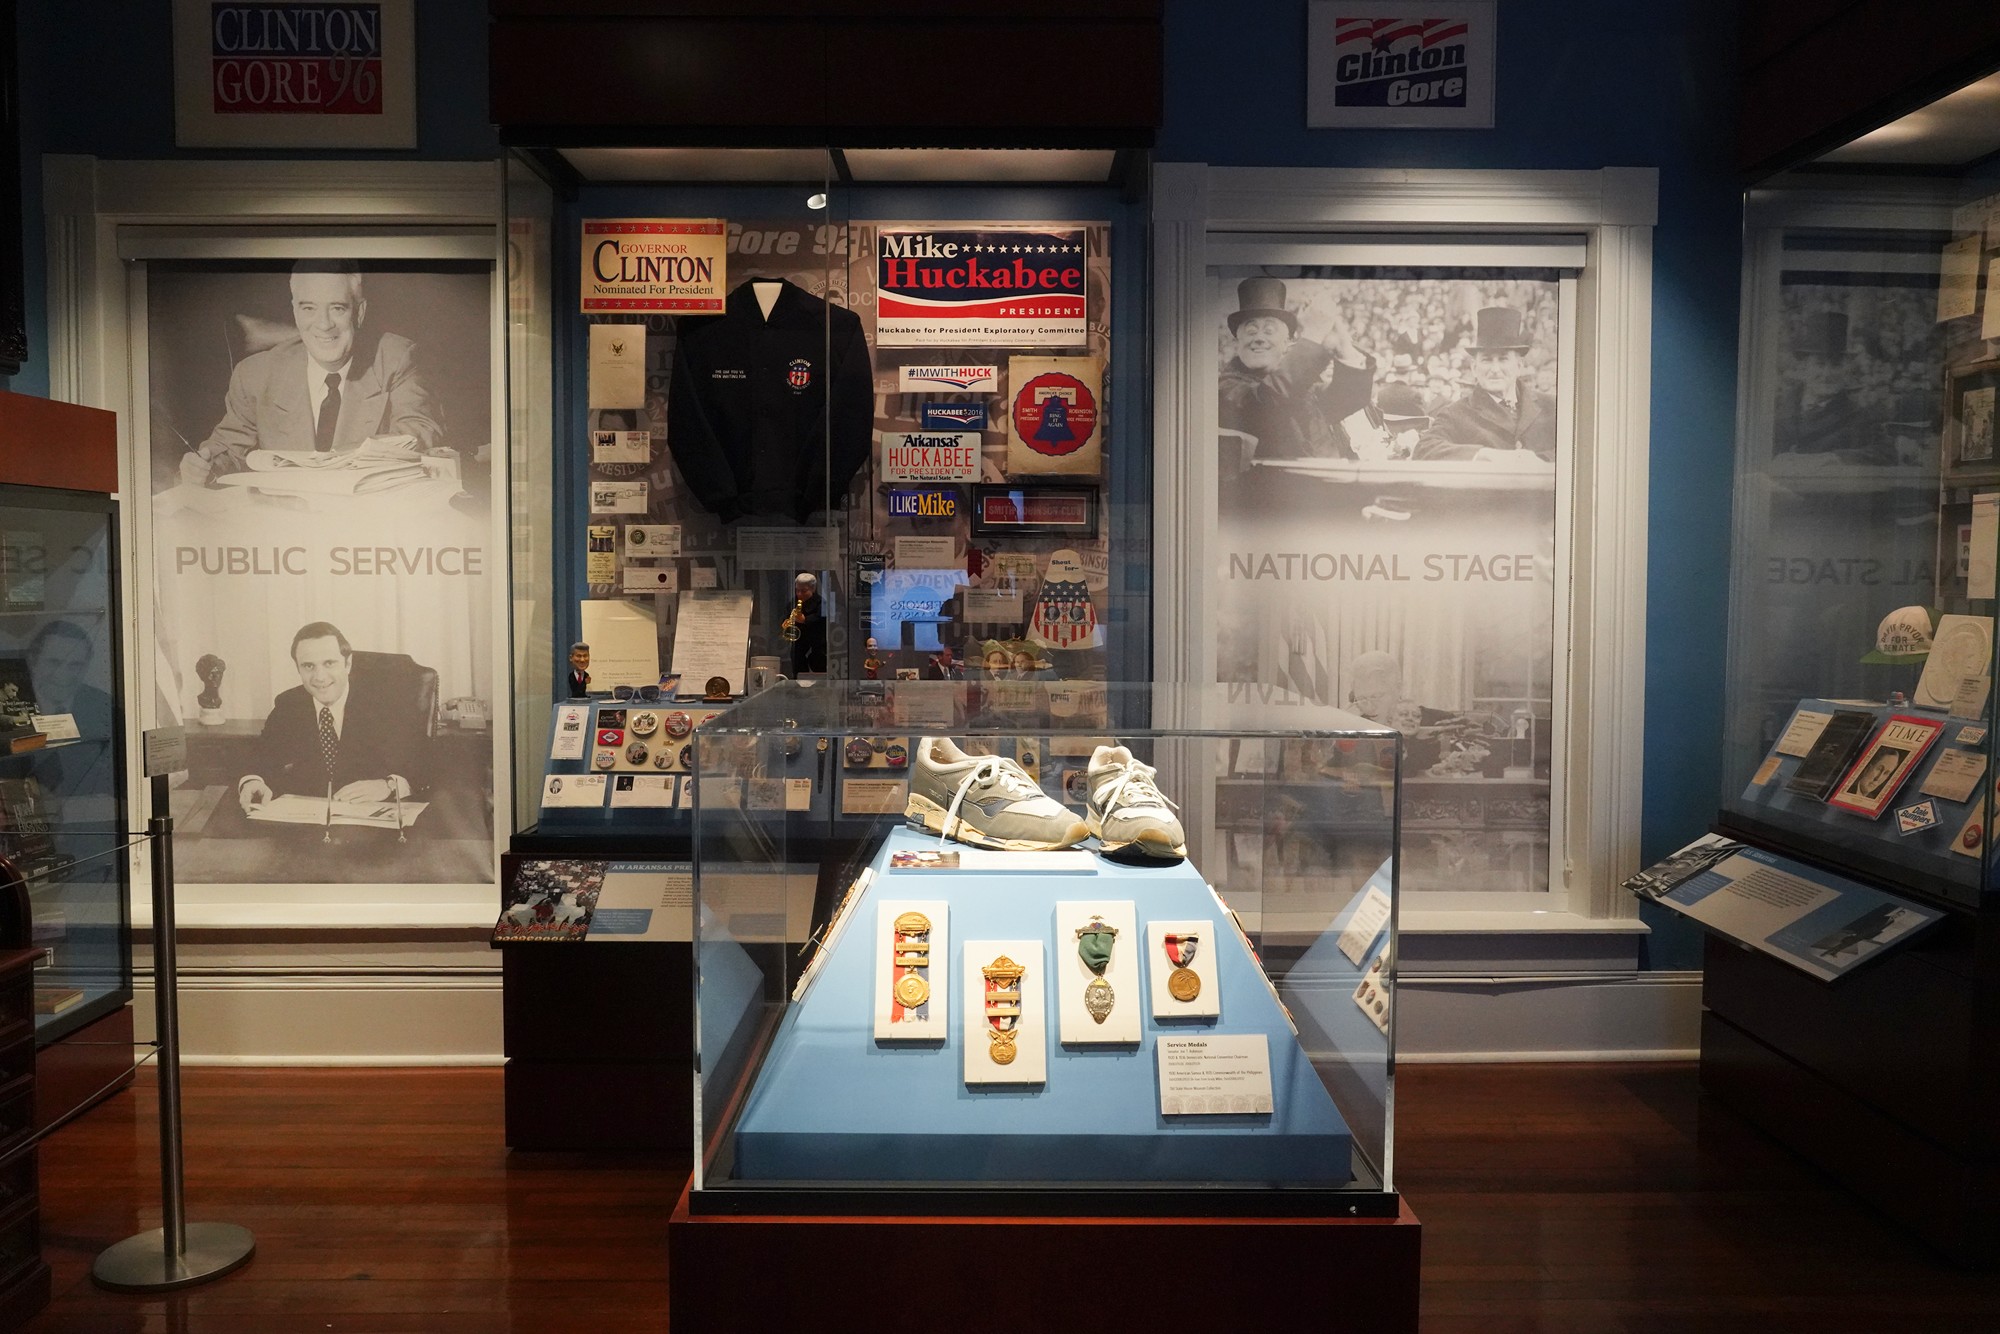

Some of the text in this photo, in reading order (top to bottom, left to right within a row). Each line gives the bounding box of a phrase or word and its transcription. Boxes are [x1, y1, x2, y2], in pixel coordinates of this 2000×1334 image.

[215, 7, 378, 52] CLINTON
[1336, 43, 1466, 83] Clinton
[216, 50, 378, 107] GORE 96
[1387, 76, 1463, 106] Gore
[727, 222, 801, 255] Gore
[882, 235, 959, 259] Mike
[620, 244, 688, 254] GOVERNOR
[592, 239, 714, 283] CLINTON
[884, 258, 1081, 289] Huckabee
[593, 284, 714, 294] Nominated For President
[1000, 307, 1081, 315] PRESIDENT
[984, 327, 1035, 335] Exploratory
[788, 358, 812, 368] CLINTON
[908, 368, 991, 378] #IMWITHHUCK
[903, 434, 960, 448] Arkansas
[889, 447, 974, 467] HUCKABEE
[890, 493, 955, 516] I LIKE Mike
[175, 546, 483, 576] PUBLIC SERVICE
[1229, 552, 1535, 582] NATIONAL STAGE
[1891, 636, 1908, 644] FOR
[1899, 623, 1924, 643] PRYOR
[1884, 644, 1916, 652] SENATE
[1888, 724, 1929, 743] TIME
[1900, 809, 1931, 825] Bumpers
[1912, 806, 1929, 817] Dale
